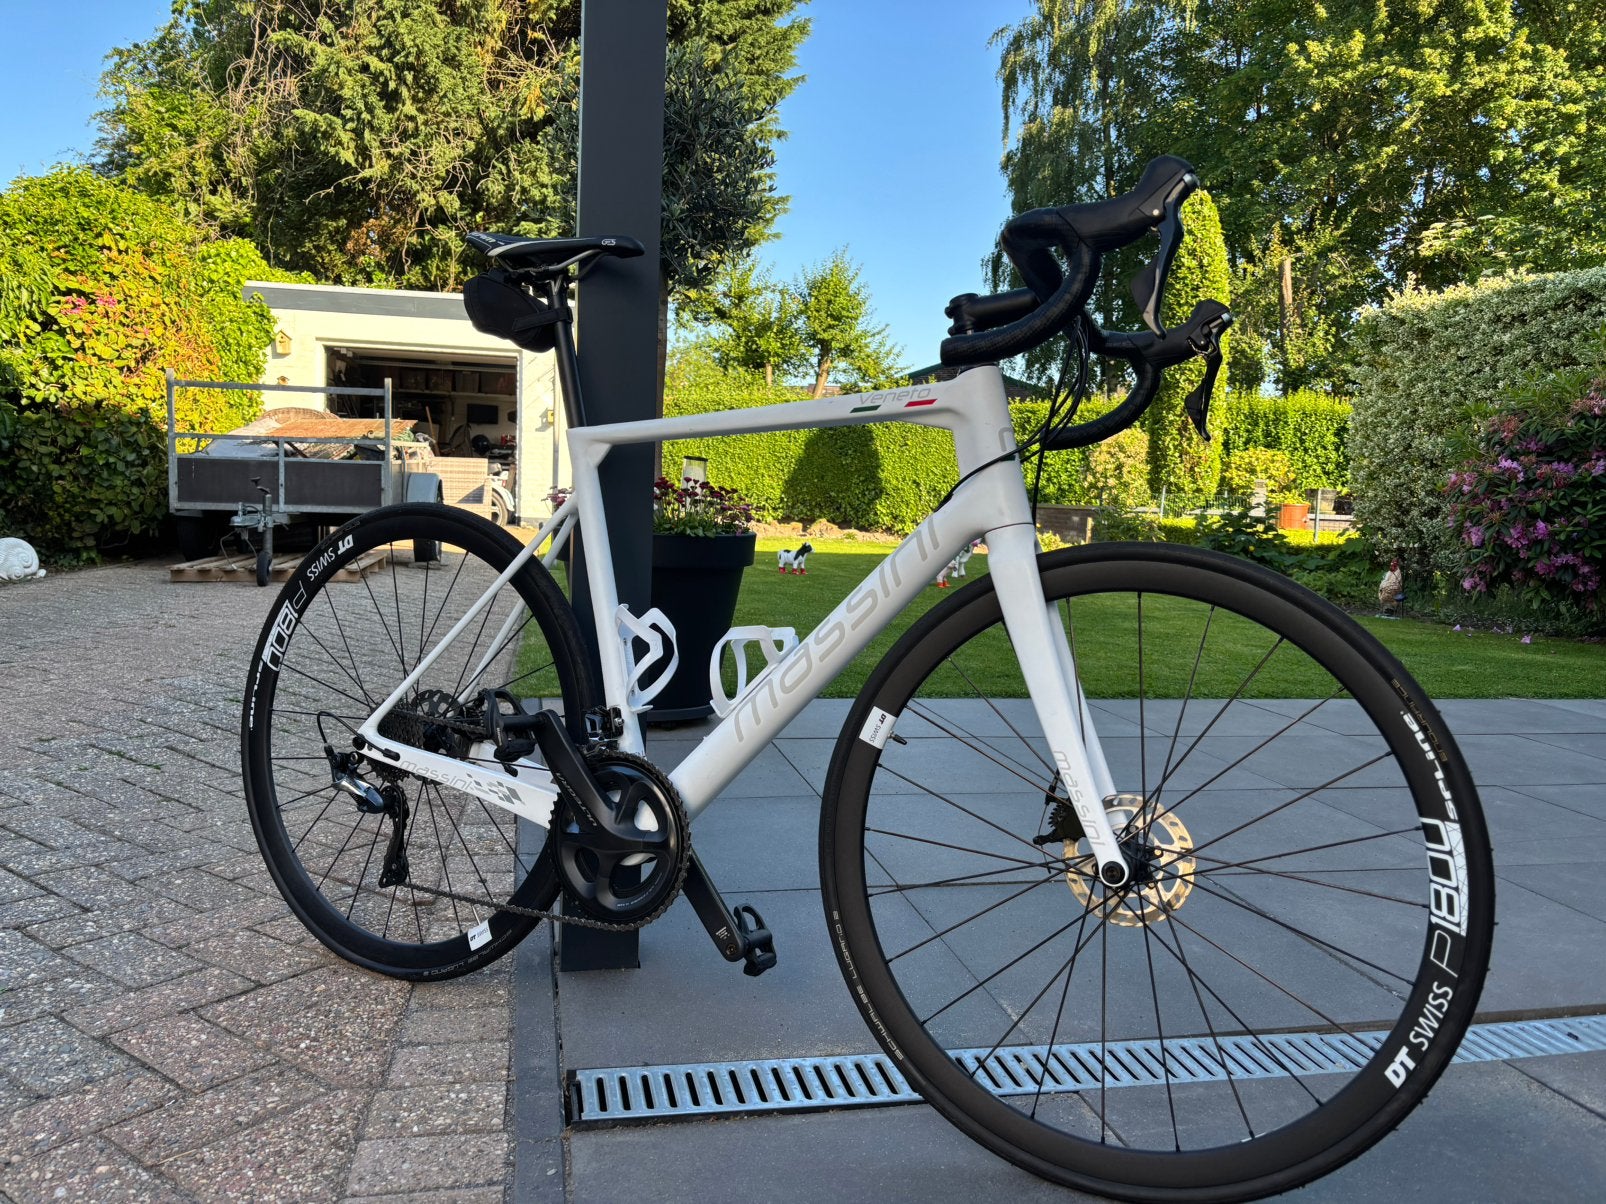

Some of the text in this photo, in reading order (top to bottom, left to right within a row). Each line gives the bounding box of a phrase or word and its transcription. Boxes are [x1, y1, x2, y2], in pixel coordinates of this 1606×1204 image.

[337, 534, 354, 555] DT
[306, 547, 336, 582] SWISS
[400, 760, 473, 790] massini
[1053, 751, 1105, 845] massini
[1384, 1045, 1417, 1089] DT
[1409, 981, 1453, 1051] SWISS
